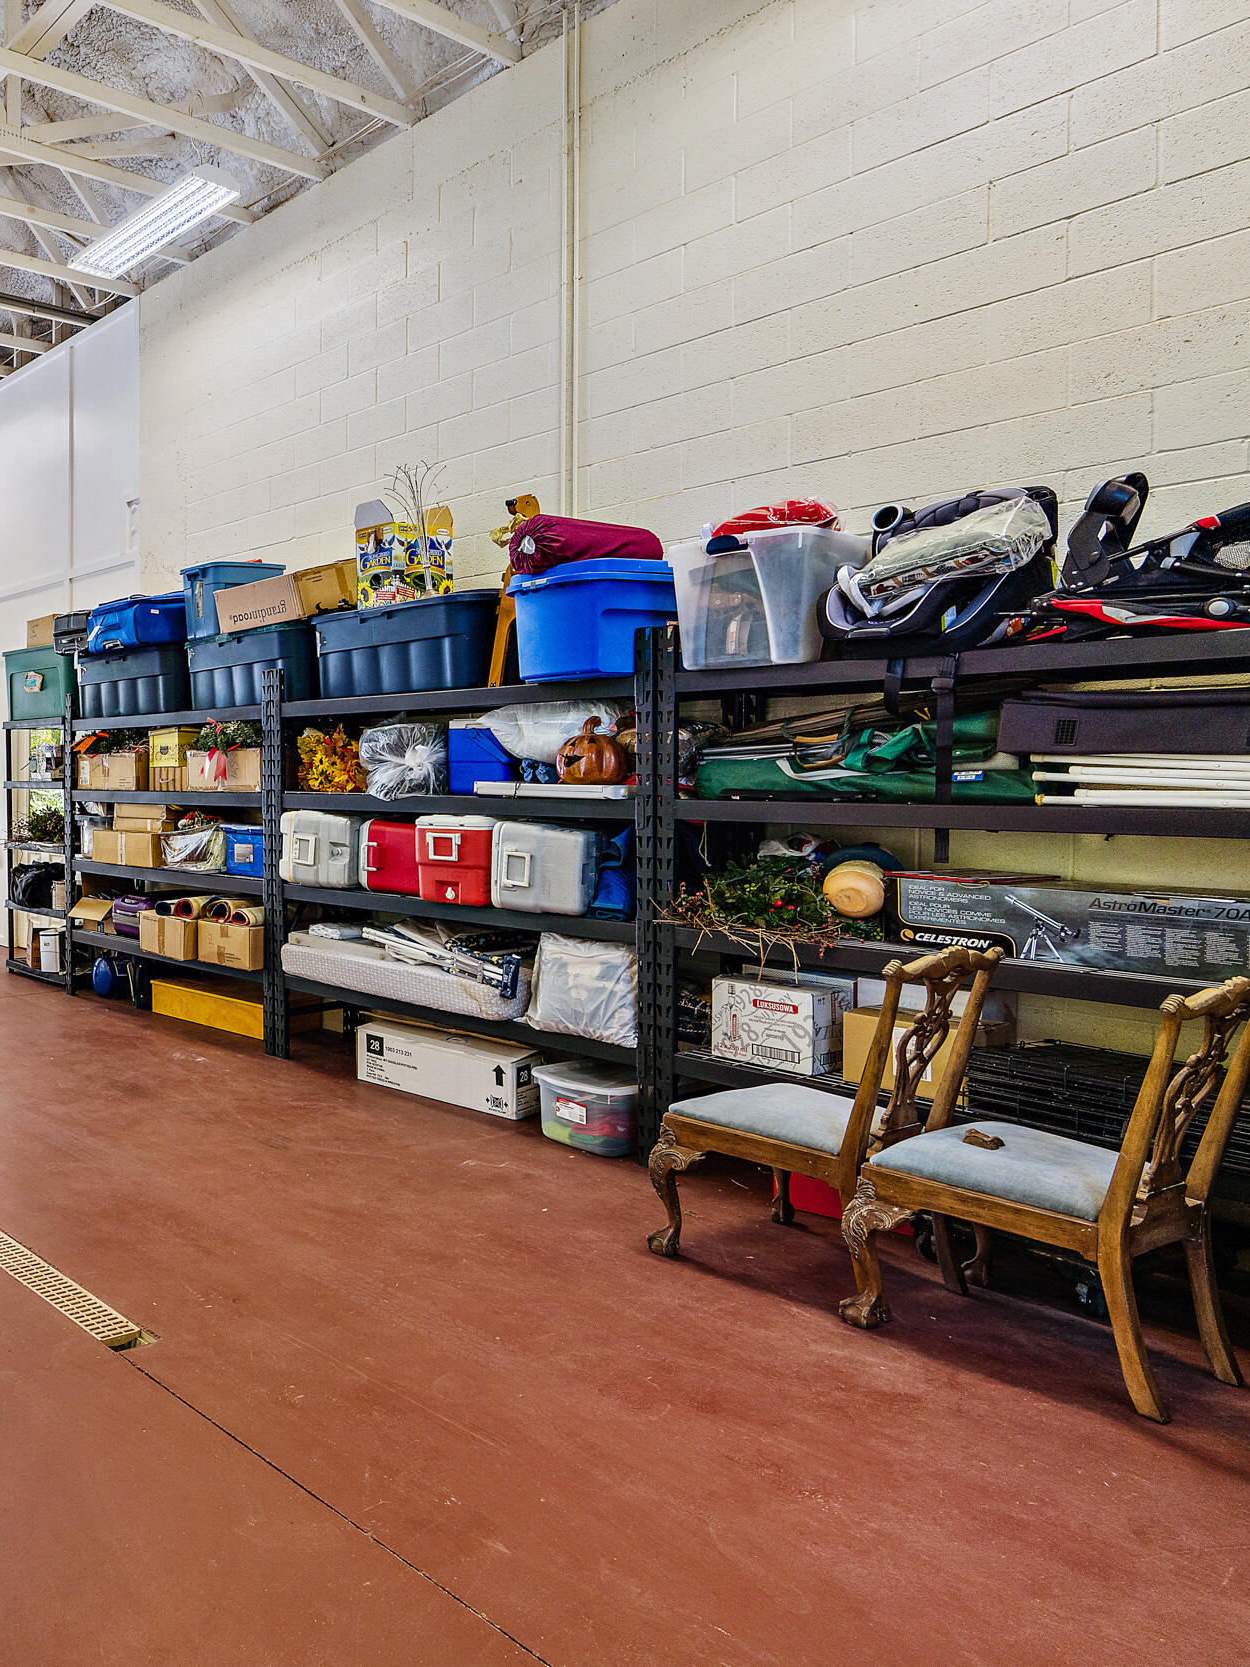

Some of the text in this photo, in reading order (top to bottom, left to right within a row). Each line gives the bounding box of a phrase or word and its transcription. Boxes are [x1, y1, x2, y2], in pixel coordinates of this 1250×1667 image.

[406, 548, 443, 567] GADEN
[233, 600, 287, 625] grandinroad
[909, 894, 969, 904] ASTRONOMERS
[947, 892, 992, 900] ADVANCED
[960, 910, 992, 918] COMME
[915, 933, 991, 948] CELESTRON
[756, 1000, 794, 1013] LUKSUSOWA
[370, 1039, 380, 1051] 28
[519, 1070, 529, 1082] 28
